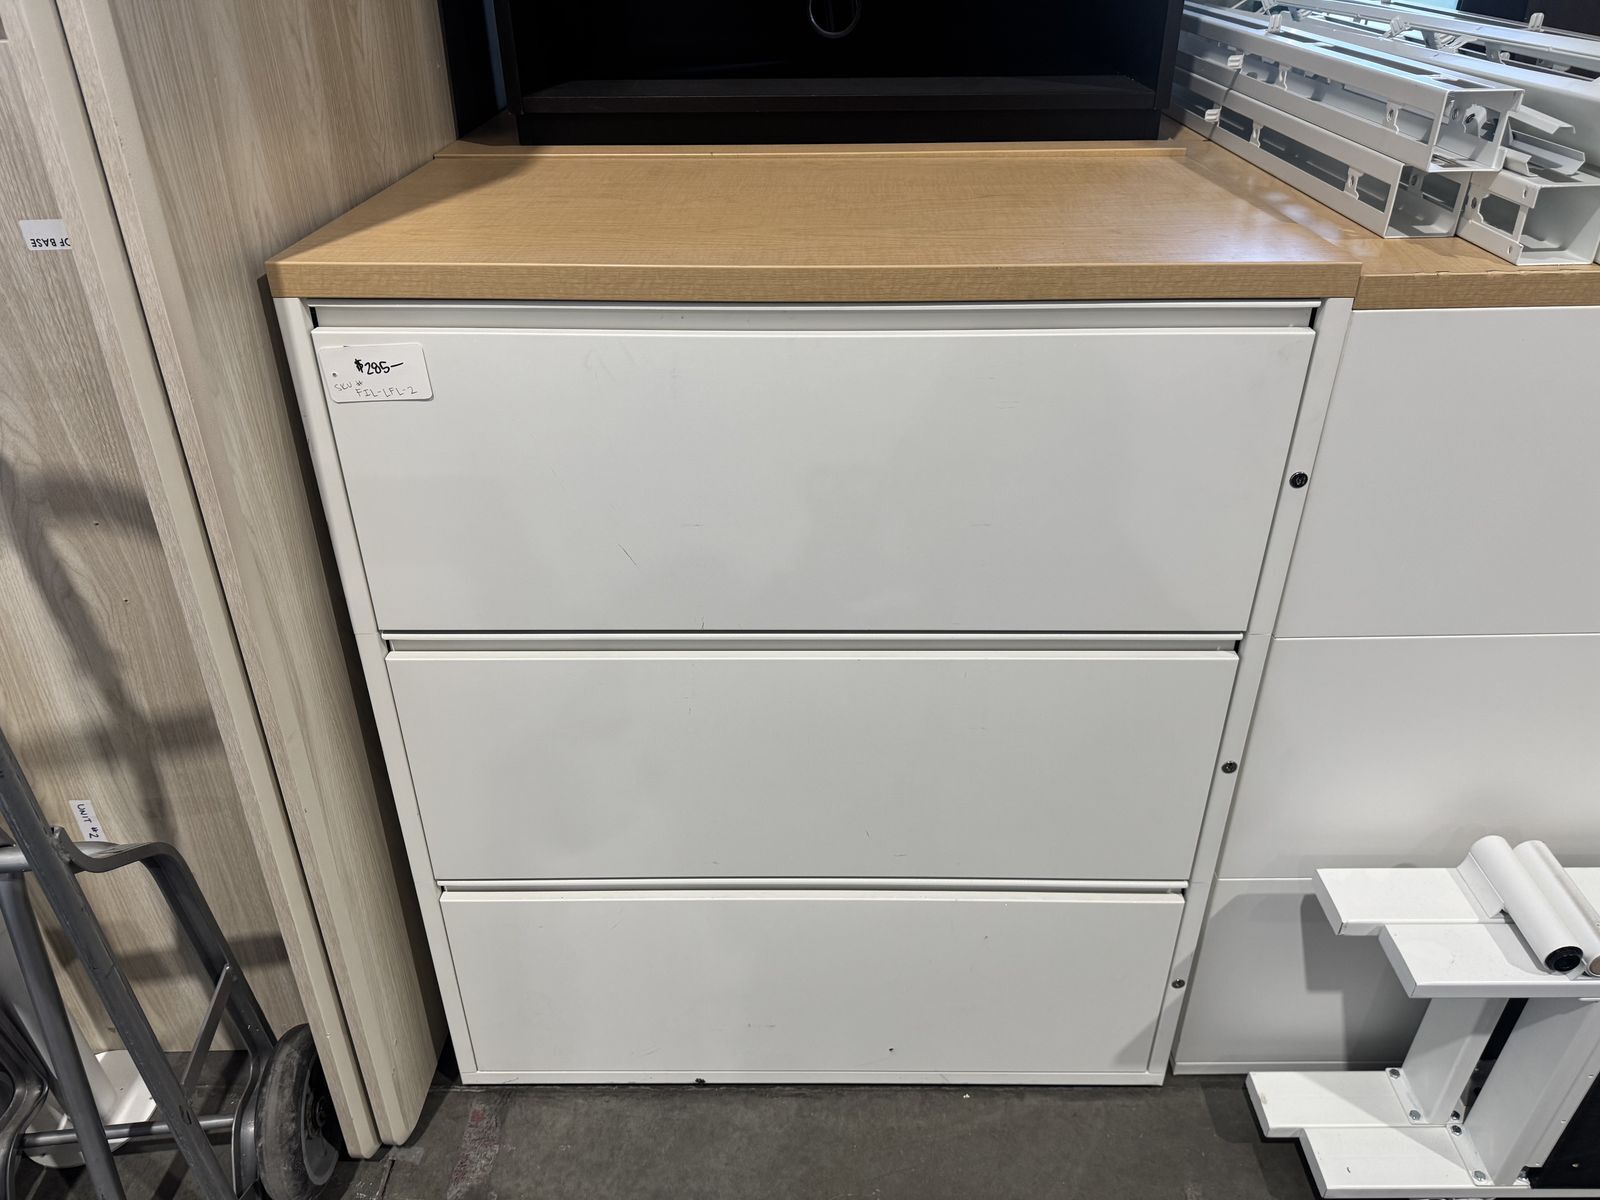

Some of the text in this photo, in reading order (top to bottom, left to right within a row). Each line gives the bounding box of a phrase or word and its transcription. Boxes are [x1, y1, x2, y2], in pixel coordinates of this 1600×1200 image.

[30, 238, 57, 248] BASE
[334, 381, 353, 392] SKU
[355, 385, 418, 398] FIL-LFL-2
[77, 803, 93, 823] UNIT
